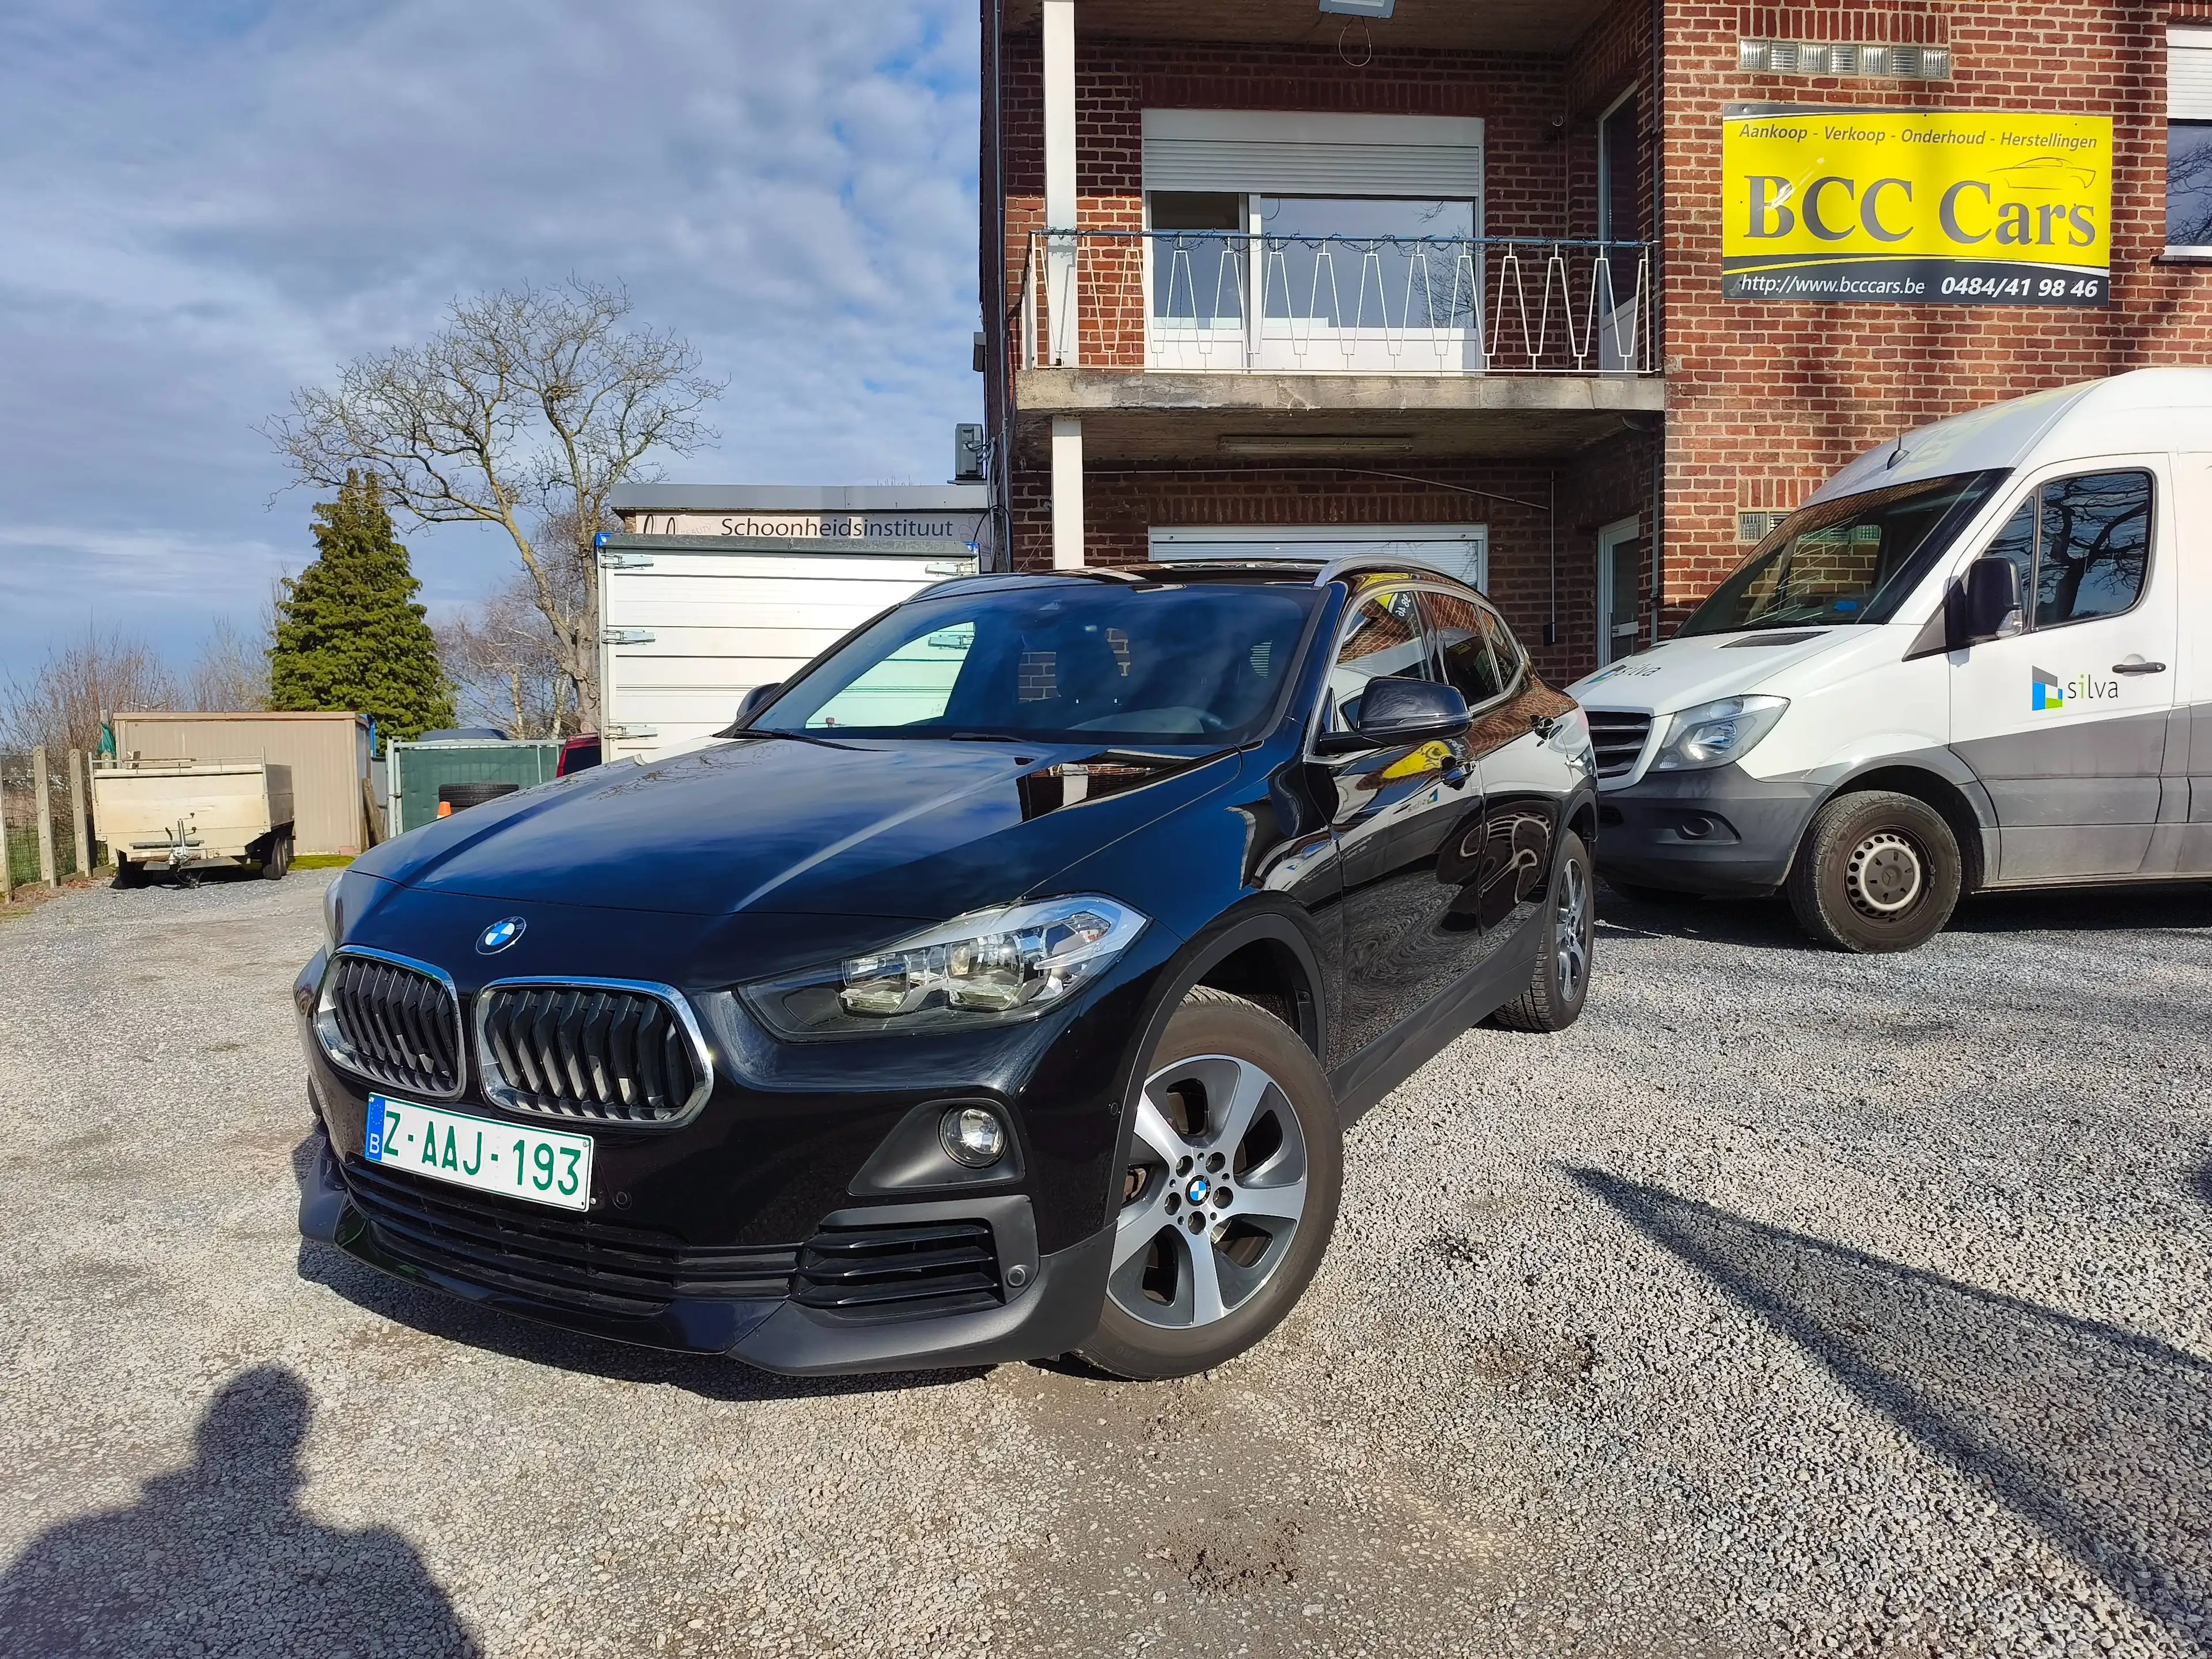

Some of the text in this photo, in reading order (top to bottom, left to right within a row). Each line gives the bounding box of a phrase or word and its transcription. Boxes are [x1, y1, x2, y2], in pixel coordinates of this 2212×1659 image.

[1738, 123, 1808, 143] Aankoop
[1824, 126, 1886, 145] Verkoop
[1901, 128, 1986, 145] Onderhoud
[2000, 131, 2097, 151] Herstellingen
[1743, 175, 2096, 247] BCC Cars
[1741, 274, 2099, 298] http://www.bcccars.be 0484/41 98 46
[721, 517, 953, 537] Schoonheidsinstituut
[1613, 663, 1662, 676] silva
[2067, 673, 2119, 699] silva
[369, 1132, 380, 1154] B
[383, 1110, 581, 1196] Z-AAJ-193
